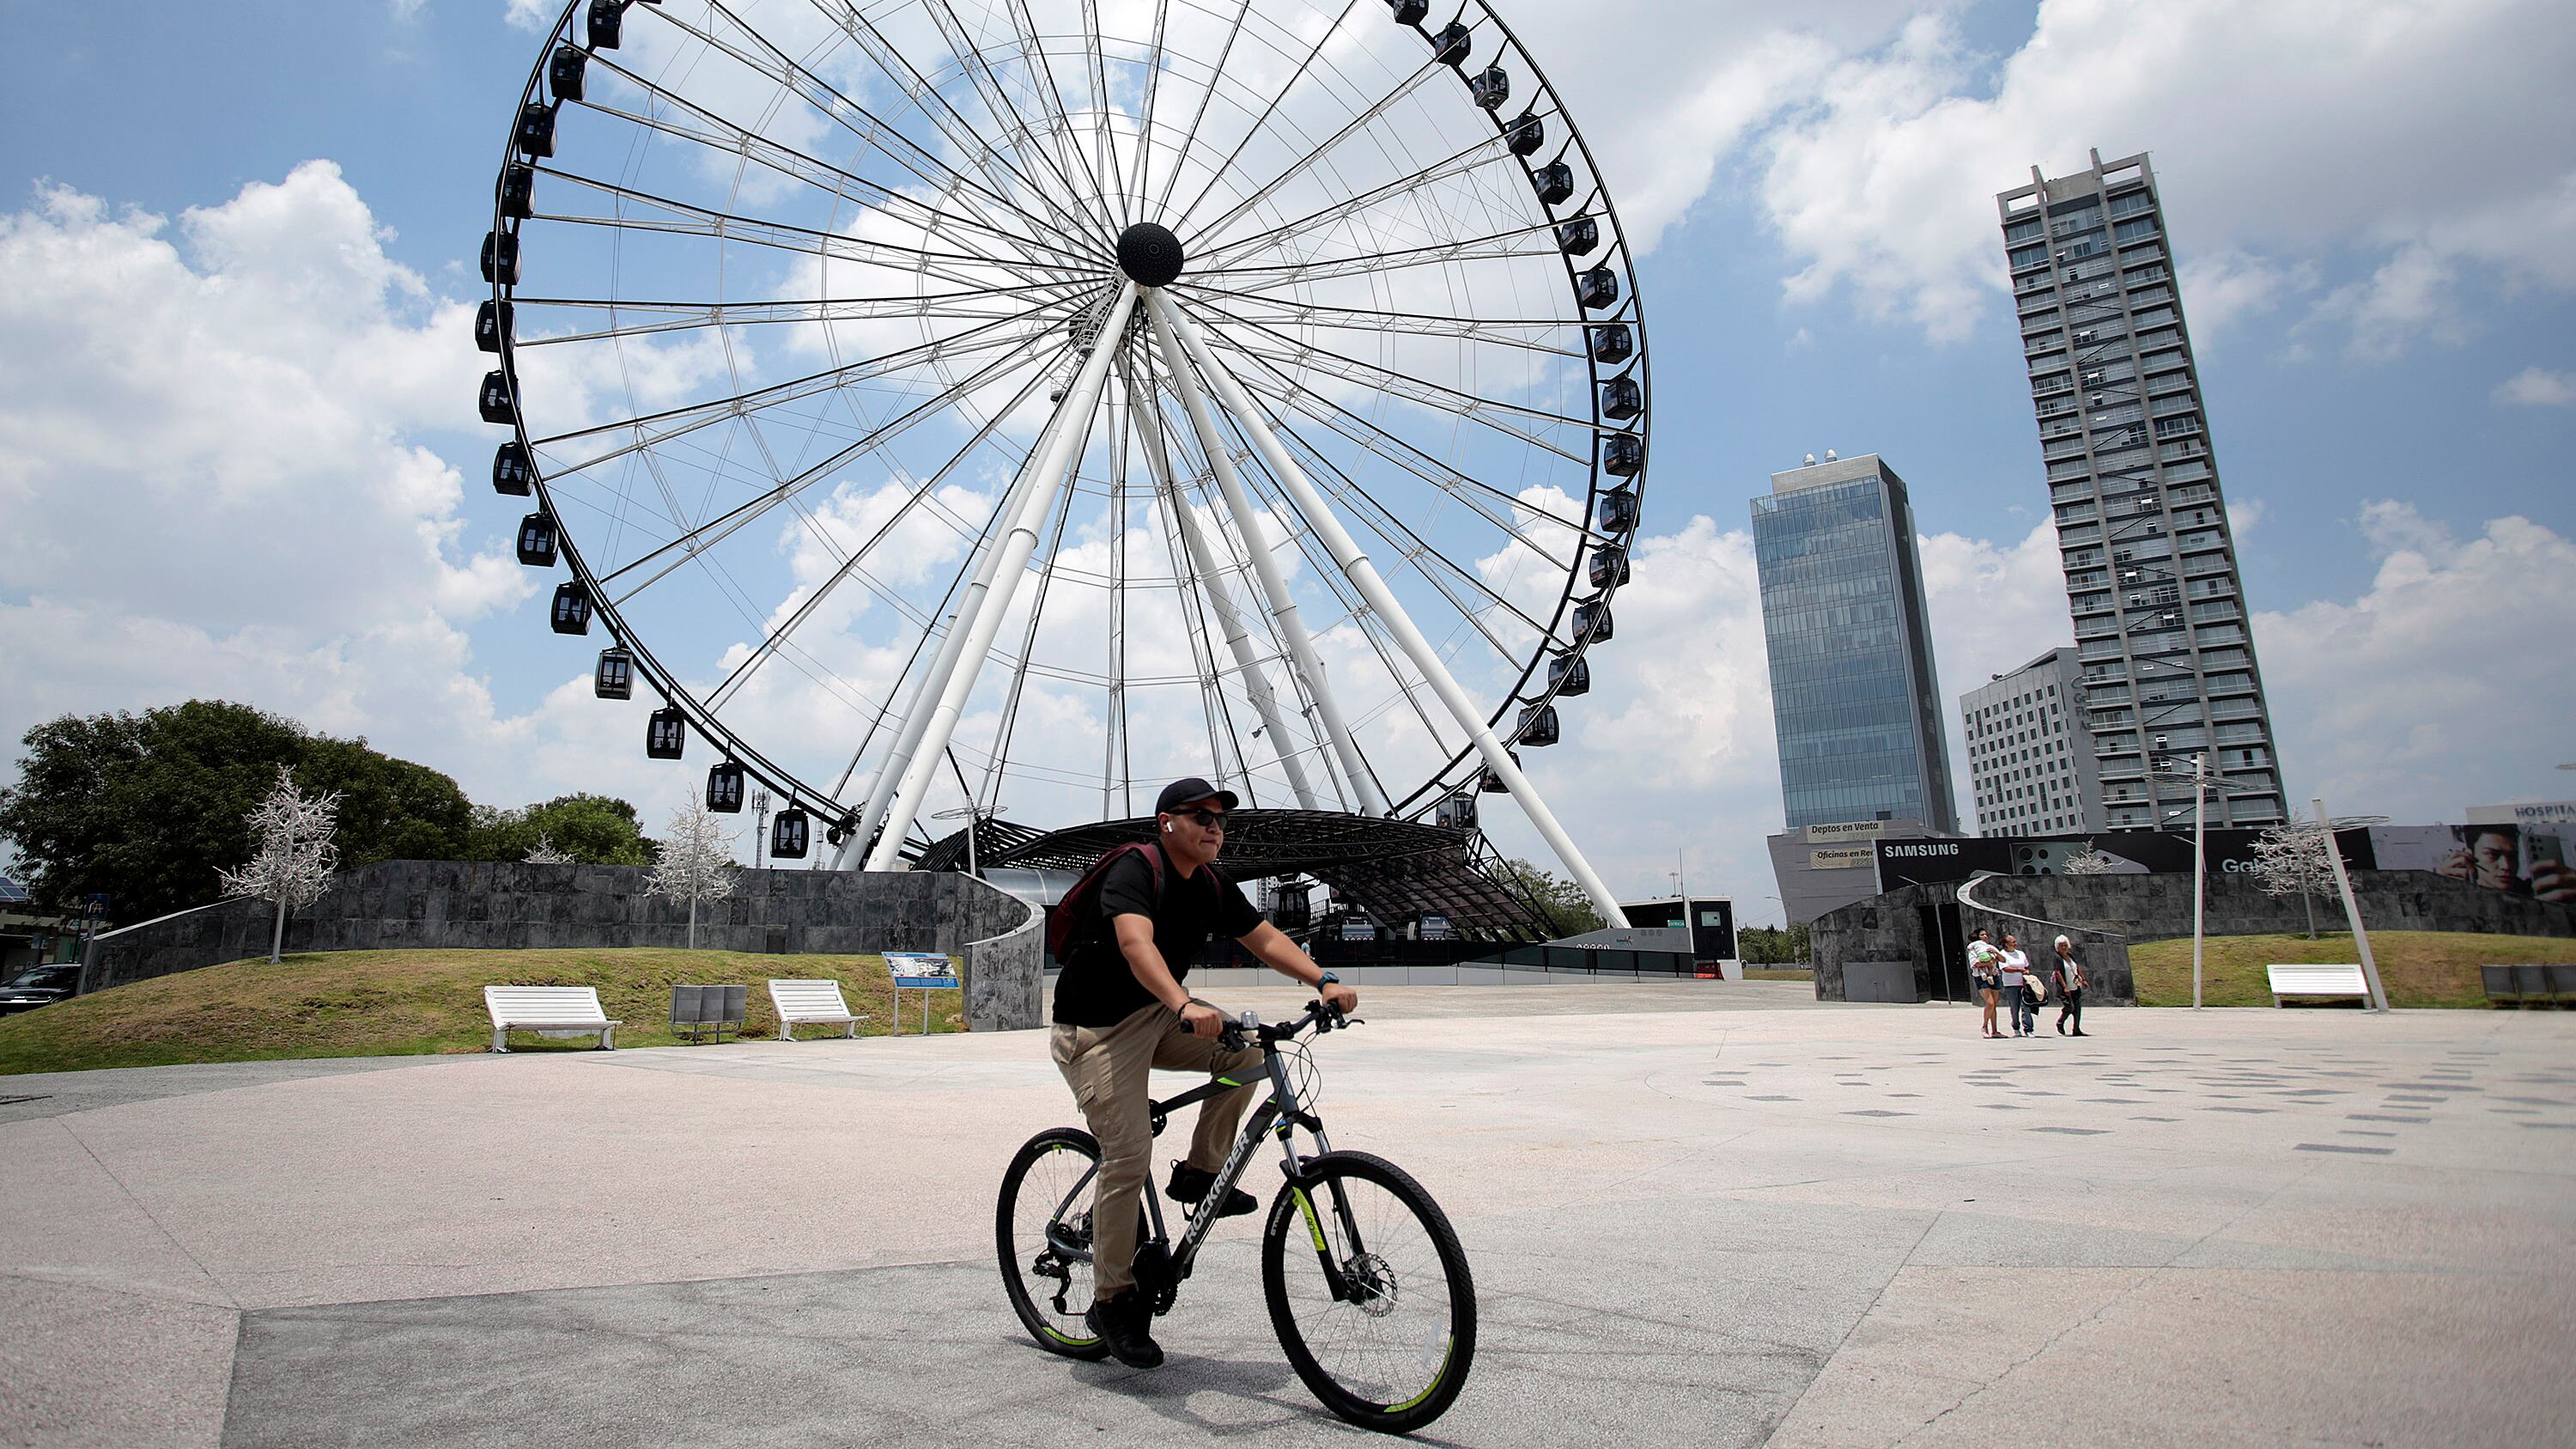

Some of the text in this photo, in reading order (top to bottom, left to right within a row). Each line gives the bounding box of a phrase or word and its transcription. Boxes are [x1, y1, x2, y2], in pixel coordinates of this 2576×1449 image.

[1812, 822, 1879, 835] Deptos en Venta
[1817, 849, 1848, 860] Oficinas
[1885, 843, 1959, 858] SAMSUNG
[1185, 1130, 1250, 1245] ROCKRIDER
